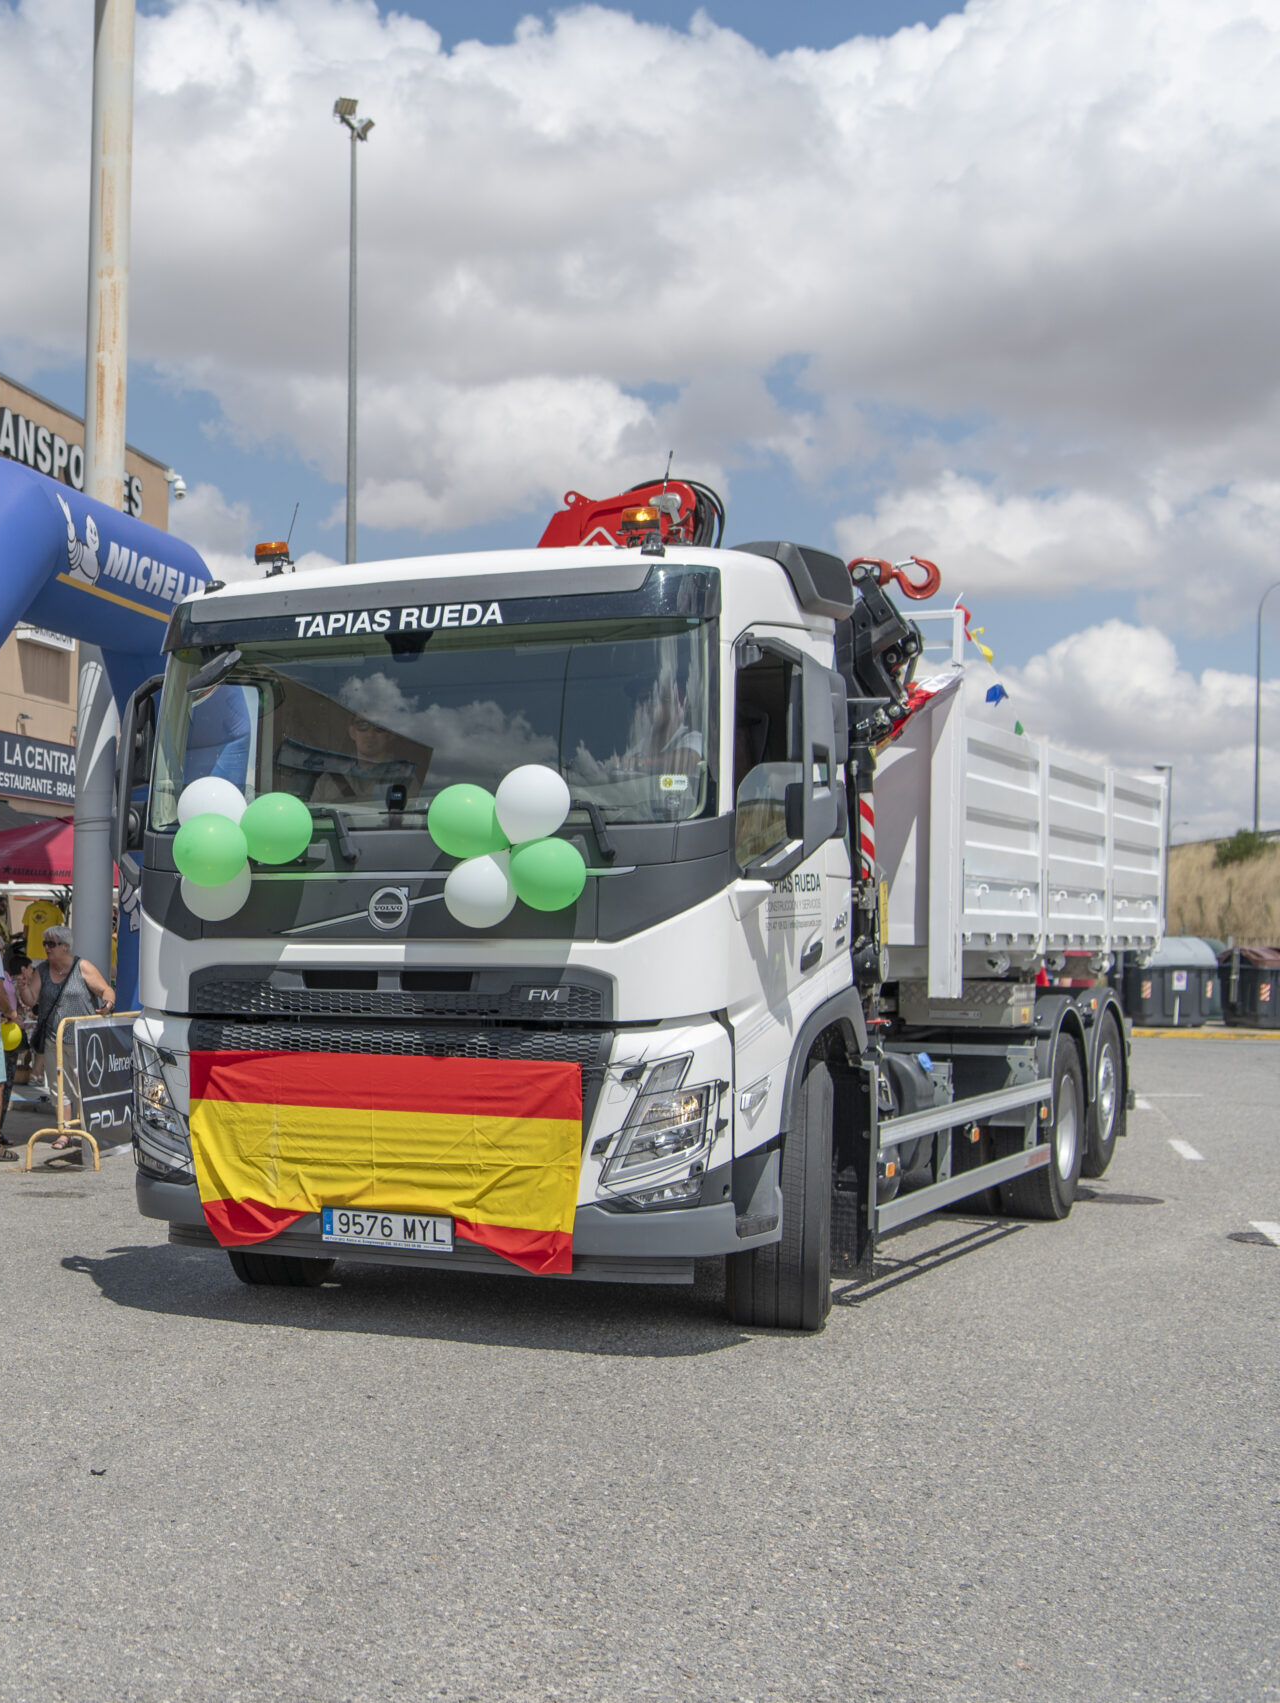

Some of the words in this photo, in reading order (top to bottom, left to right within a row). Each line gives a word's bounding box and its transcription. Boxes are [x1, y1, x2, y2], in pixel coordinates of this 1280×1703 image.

[295, 609, 391, 638] TAPIAS
[399, 602, 503, 630] RUEDA
[4, 740, 22, 766] LA
[25, 746, 76, 776] CENTRA
[794, 873, 821, 892] RUEDA
[528, 989, 560, 1001] FM
[338, 1213, 393, 1238] 9576
[403, 1218, 446, 1243] MYL
